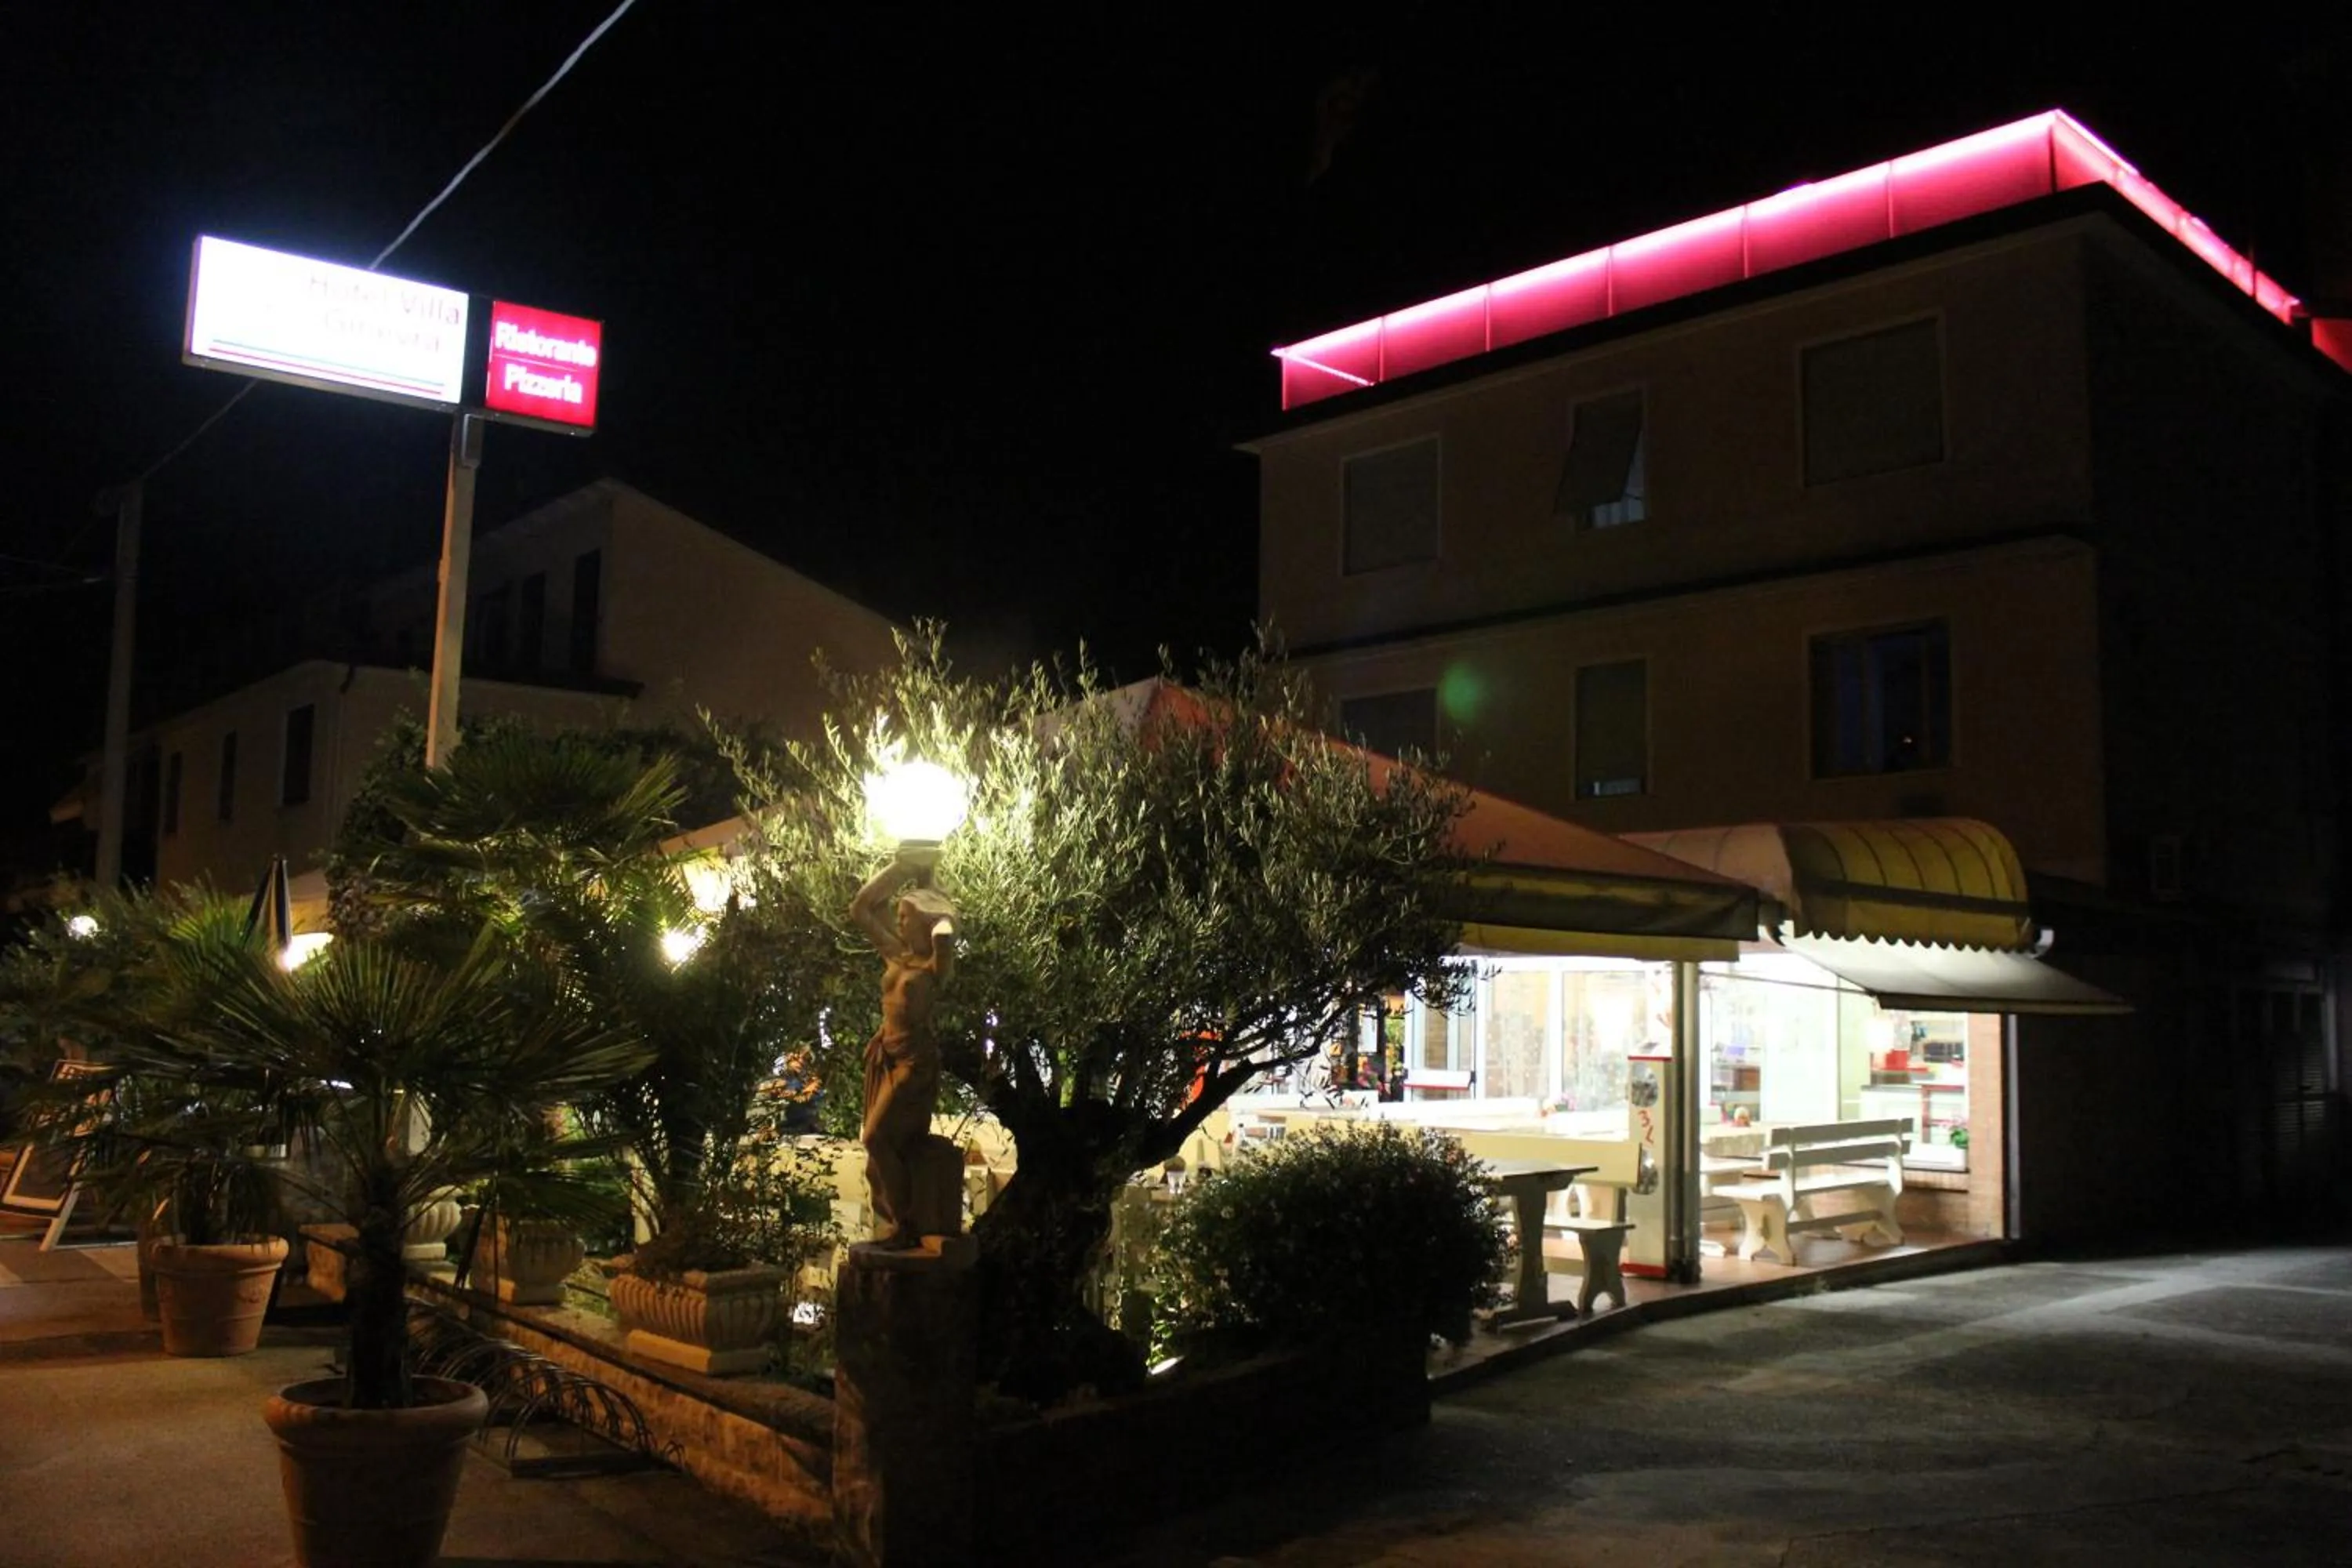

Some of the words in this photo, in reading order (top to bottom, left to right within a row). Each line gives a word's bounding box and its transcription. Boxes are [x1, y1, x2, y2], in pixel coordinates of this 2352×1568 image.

[310, 274, 388, 301] Hotel
[401, 291, 461, 325] Villa
[495, 321, 597, 367] Ristorante
[504, 363, 583, 404] Pizzeria
